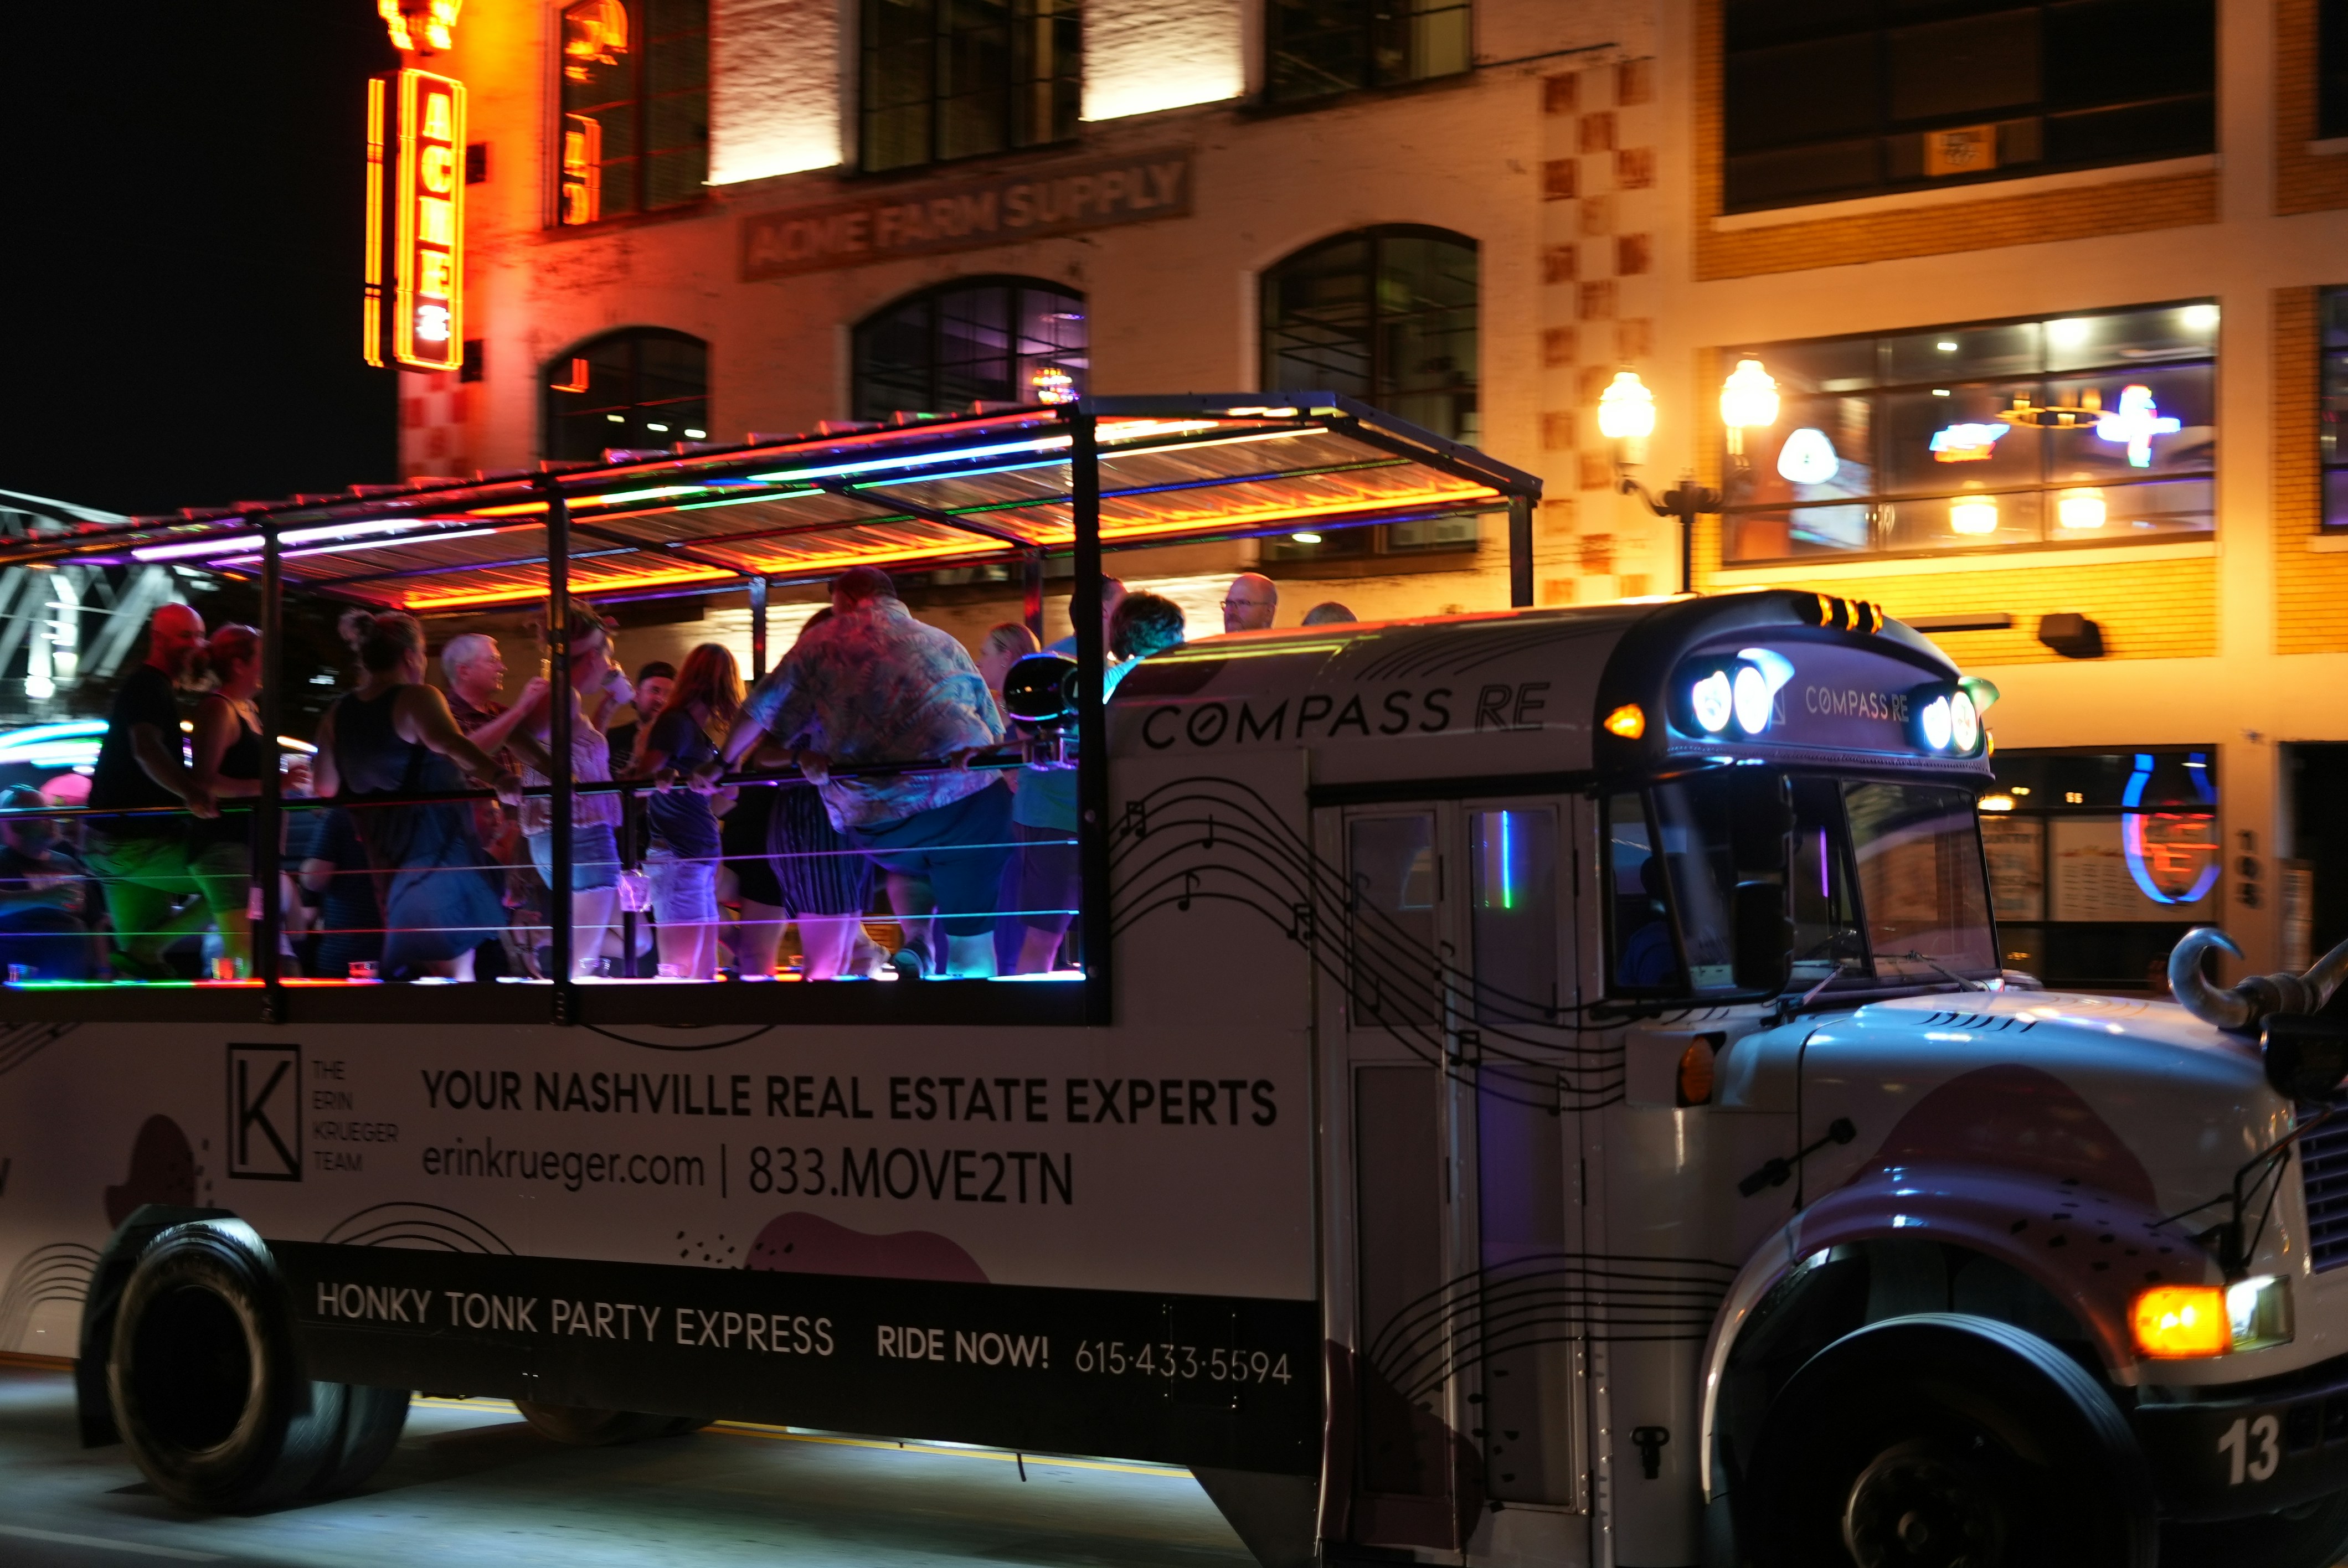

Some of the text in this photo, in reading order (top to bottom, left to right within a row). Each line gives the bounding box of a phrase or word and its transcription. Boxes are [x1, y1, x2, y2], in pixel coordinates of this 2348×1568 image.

[878, 190, 996, 247] FARM
[1007, 163, 1186, 227] SUPPLY
[1142, 682, 1551, 749] COMPASS RE
[1806, 685, 1909, 722] COMPASS RE
[312, 1060, 345, 1080] THE
[421, 1070, 1277, 1127] YOUR NASHVILLE REAL ESTATE EXPERTS
[312, 1091, 353, 1110] ERIN
[313, 1121, 399, 1142] KRUEGER
[312, 1151, 363, 1172] TEAM
[423, 1136, 705, 1192] erinkrueger.com
[749, 1146, 1072, 1205] 833.MOVE2TN
[317, 1281, 433, 1324] HONKY
[444, 1290, 539, 1333] TONK
[550, 1298, 662, 1343] PARTY
[676, 1307, 835, 1356] EXPRESS
[878, 1324, 945, 1361] RIDE
[955, 1330, 1049, 1369] NOW!
[2217, 1414, 2280, 1487] 13
